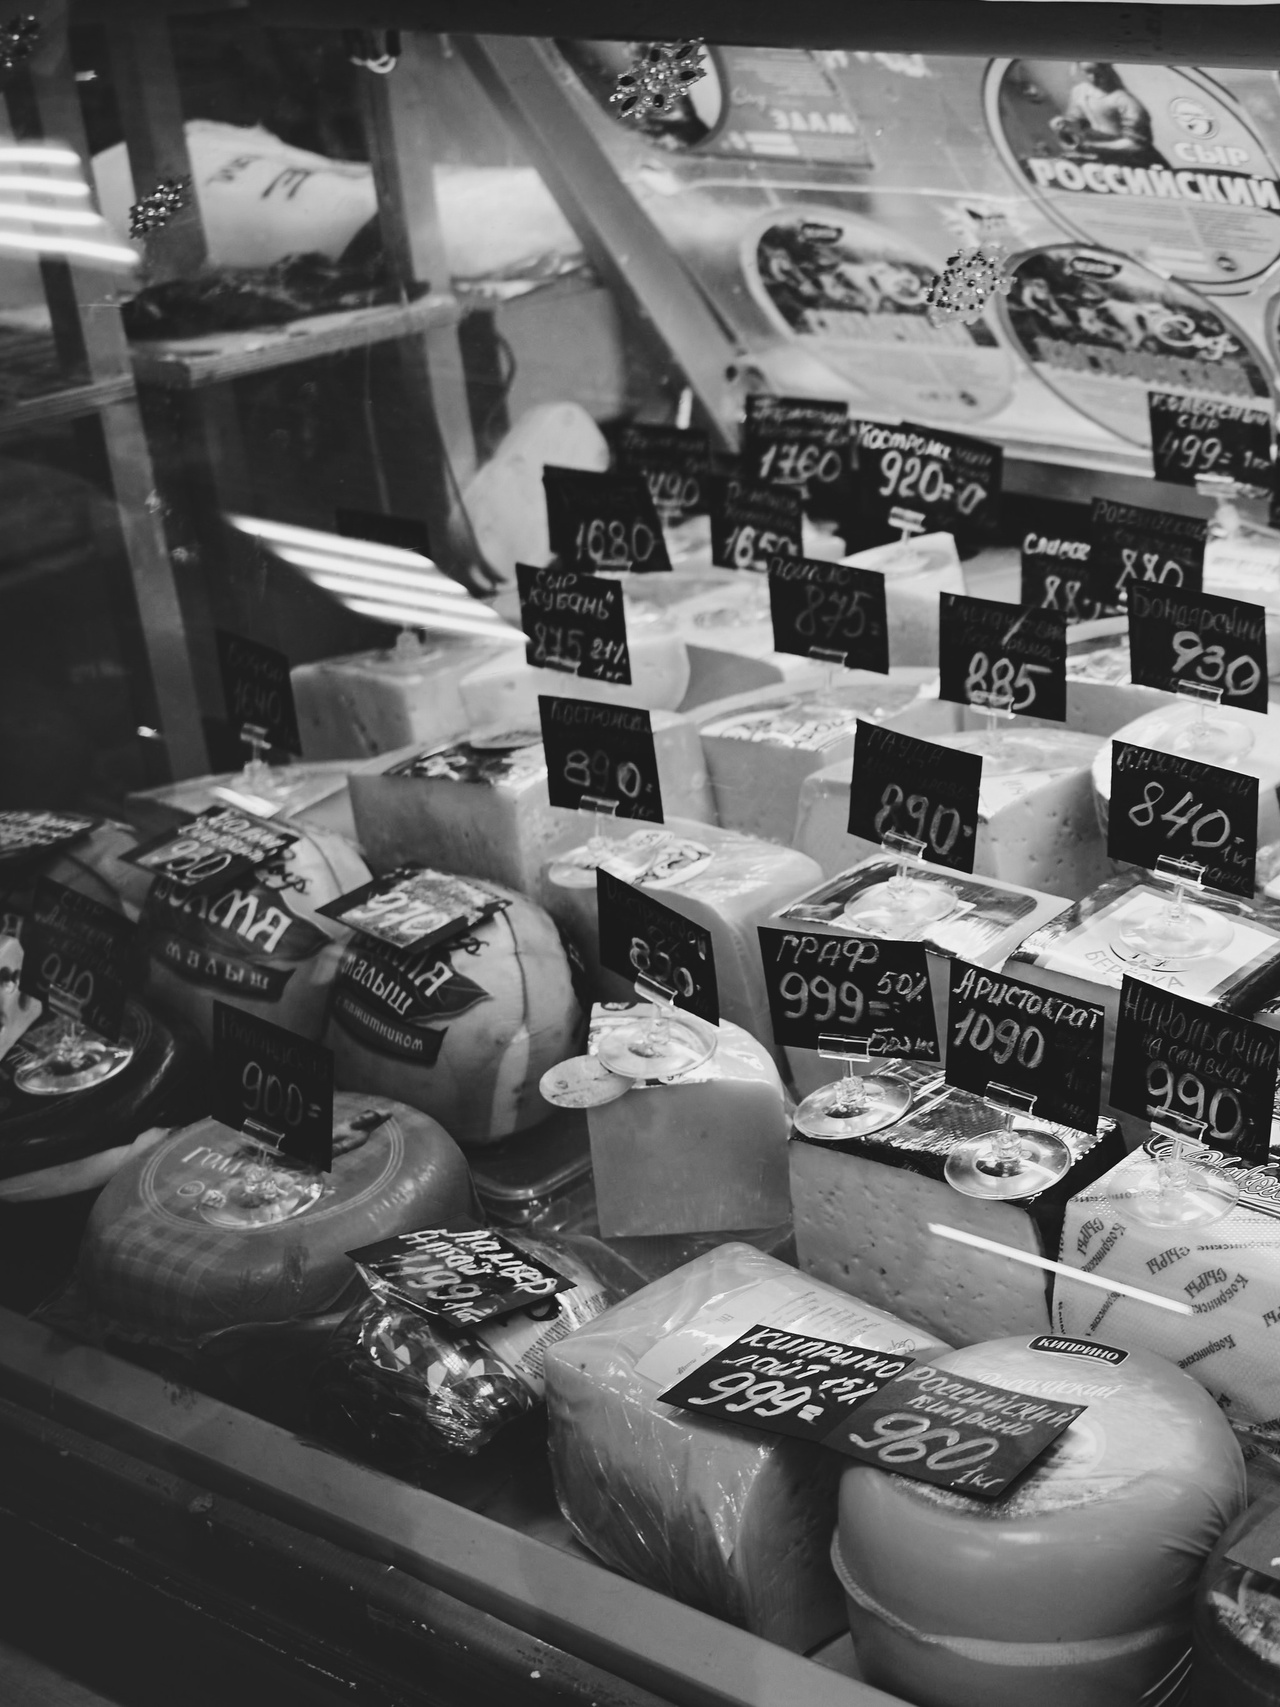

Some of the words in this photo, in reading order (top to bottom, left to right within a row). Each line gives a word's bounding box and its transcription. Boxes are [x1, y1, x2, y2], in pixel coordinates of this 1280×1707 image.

[1174, 142, 1250, 167] СЫР
[575, 518, 656, 562] 1680
[1170, 630, 1261, 697] 930
[1127, 781, 1232, 848] 840
[776, 933, 881, 972] ГРАФ
[954, 1008, 1046, 1070] 1090
[1146, 1060, 1243, 1141] 990
[1077, 1217, 1105, 1256] СЫРЫ
[1144, 1245, 1191, 1276] СЫРЫ
[1183, 1267, 1228, 1300] СЫРЫ
[1037, 1338, 1119, 1361] КИПРИНО
[848, 1411, 1000, 1471] 960
